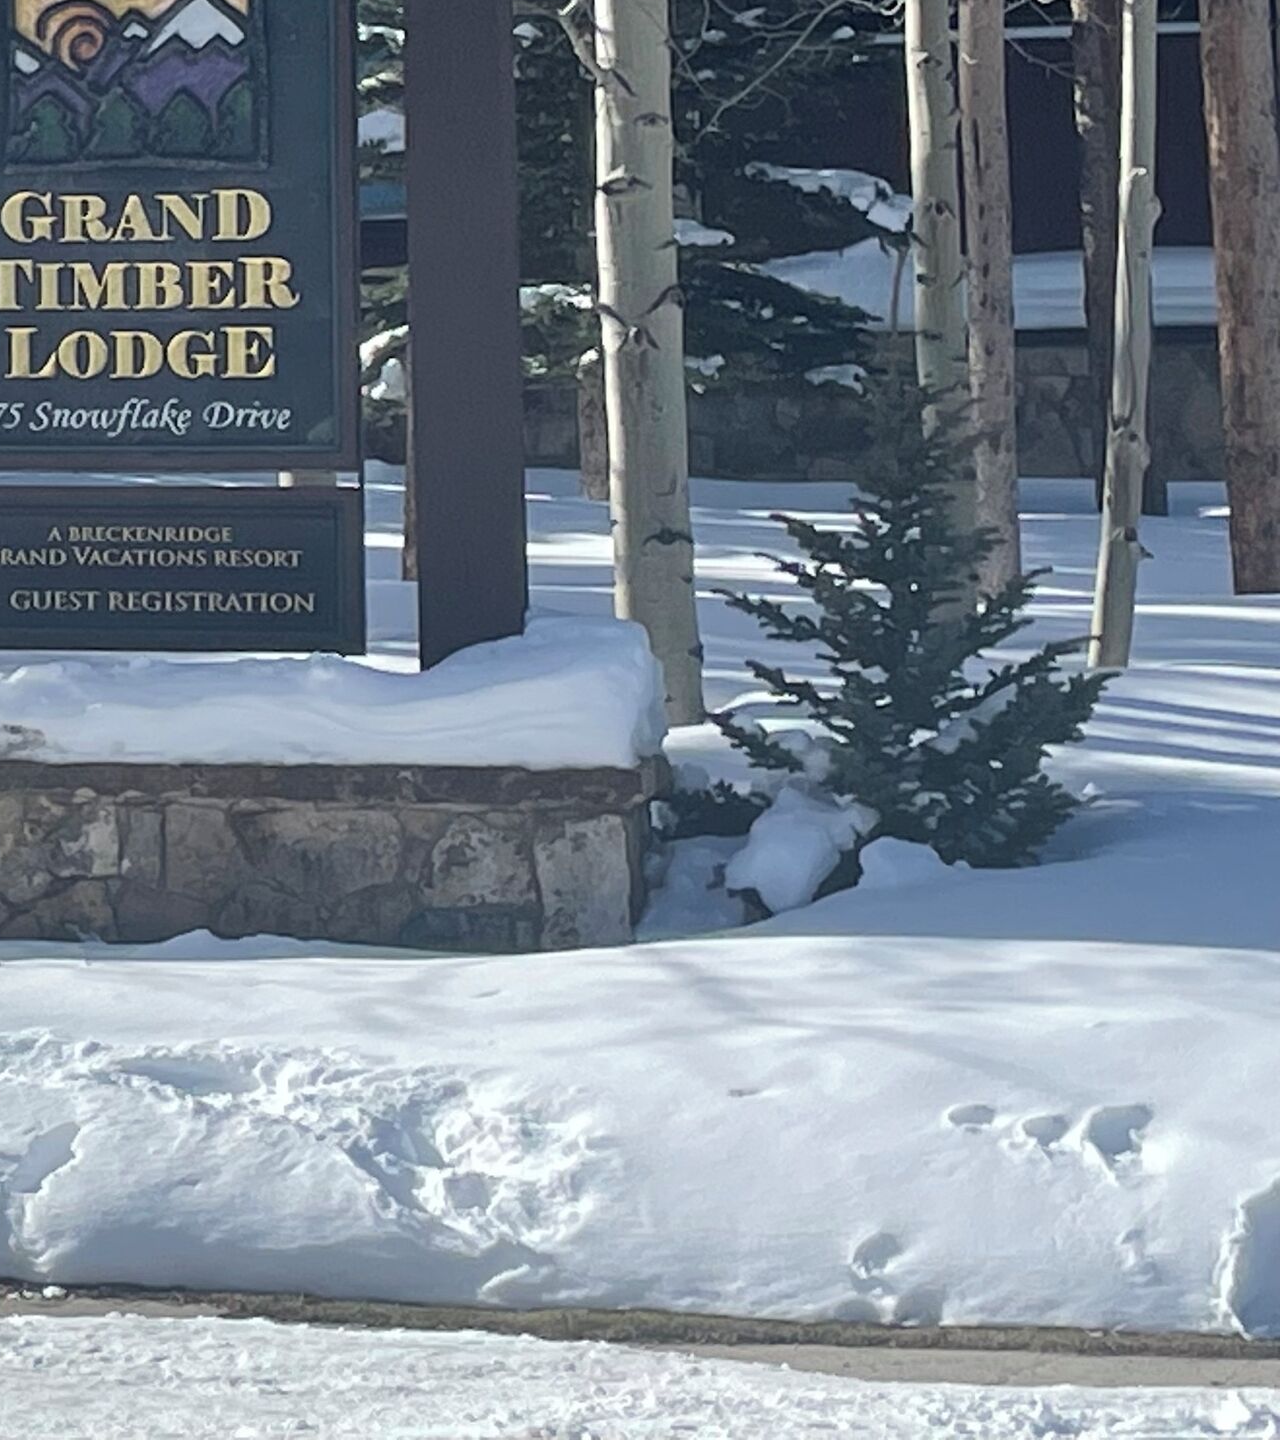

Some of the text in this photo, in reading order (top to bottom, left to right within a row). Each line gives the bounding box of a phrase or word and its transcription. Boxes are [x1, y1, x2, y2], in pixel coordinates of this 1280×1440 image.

[0, 188, 272, 244] GRAND
[3, 326, 276, 380] LODGE
[28, 398, 192, 437] Snowflake
[202, 401, 291, 430] Drive
[47, 526, 233, 543] A BRECKENRIDGE
[71, 546, 207, 568] VACATIONS
[214, 549, 303, 568] RESORT
[9, 589, 316, 614] GUEST REGISTRATION
